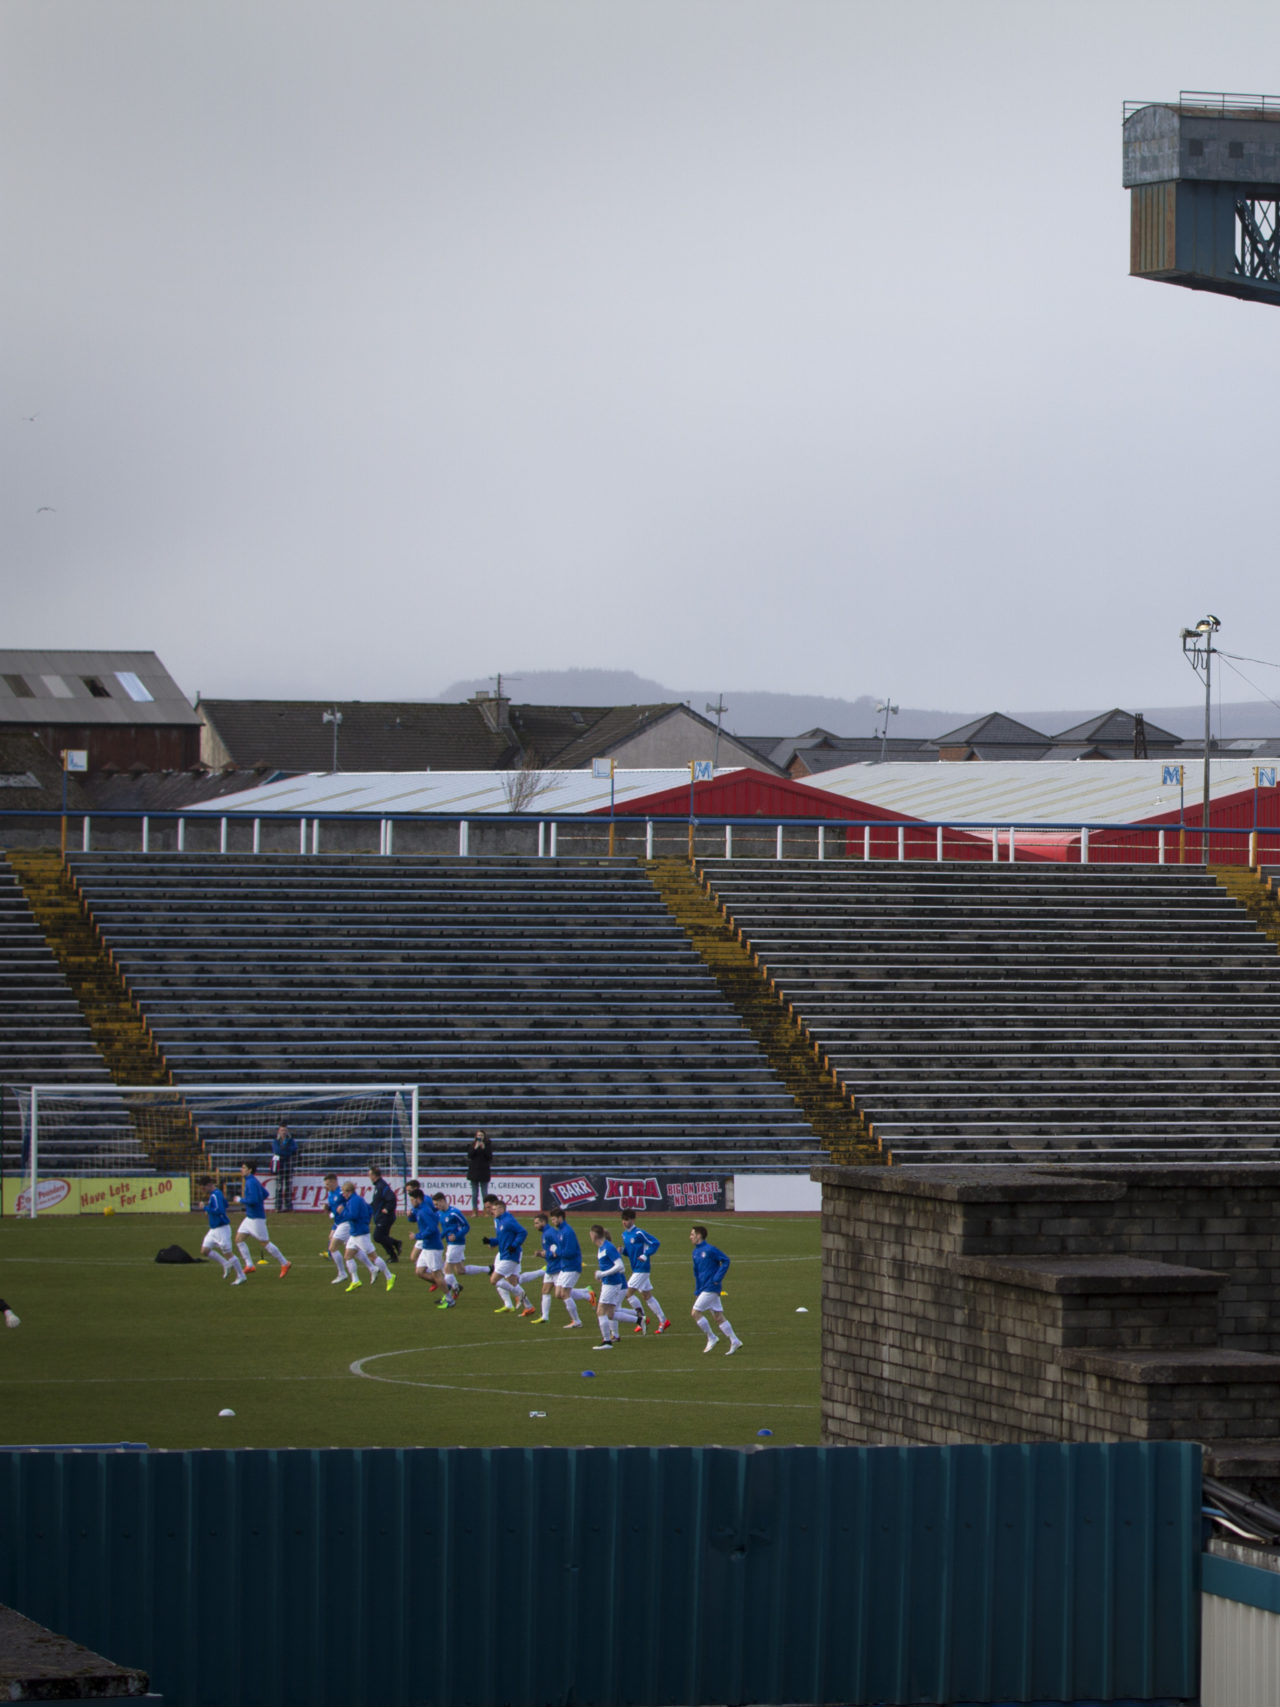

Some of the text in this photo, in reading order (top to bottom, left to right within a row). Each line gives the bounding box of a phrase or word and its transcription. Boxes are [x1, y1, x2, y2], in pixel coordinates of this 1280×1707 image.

[694, 761, 713, 779] M
[1163, 766, 1180, 784] M
[1260, 767, 1275, 786] N
[80, 1191, 105, 1207] Have
[109, 1182, 130, 1198] Lots
[120, 1179, 173, 1208] For £1.00
[557, 1180, 592, 1200] BARR
[606, 1178, 661, 1199] XTRA
[667, 1181, 722, 1196] BIG ON TASTE.
[674, 1194, 685, 1206] NO
